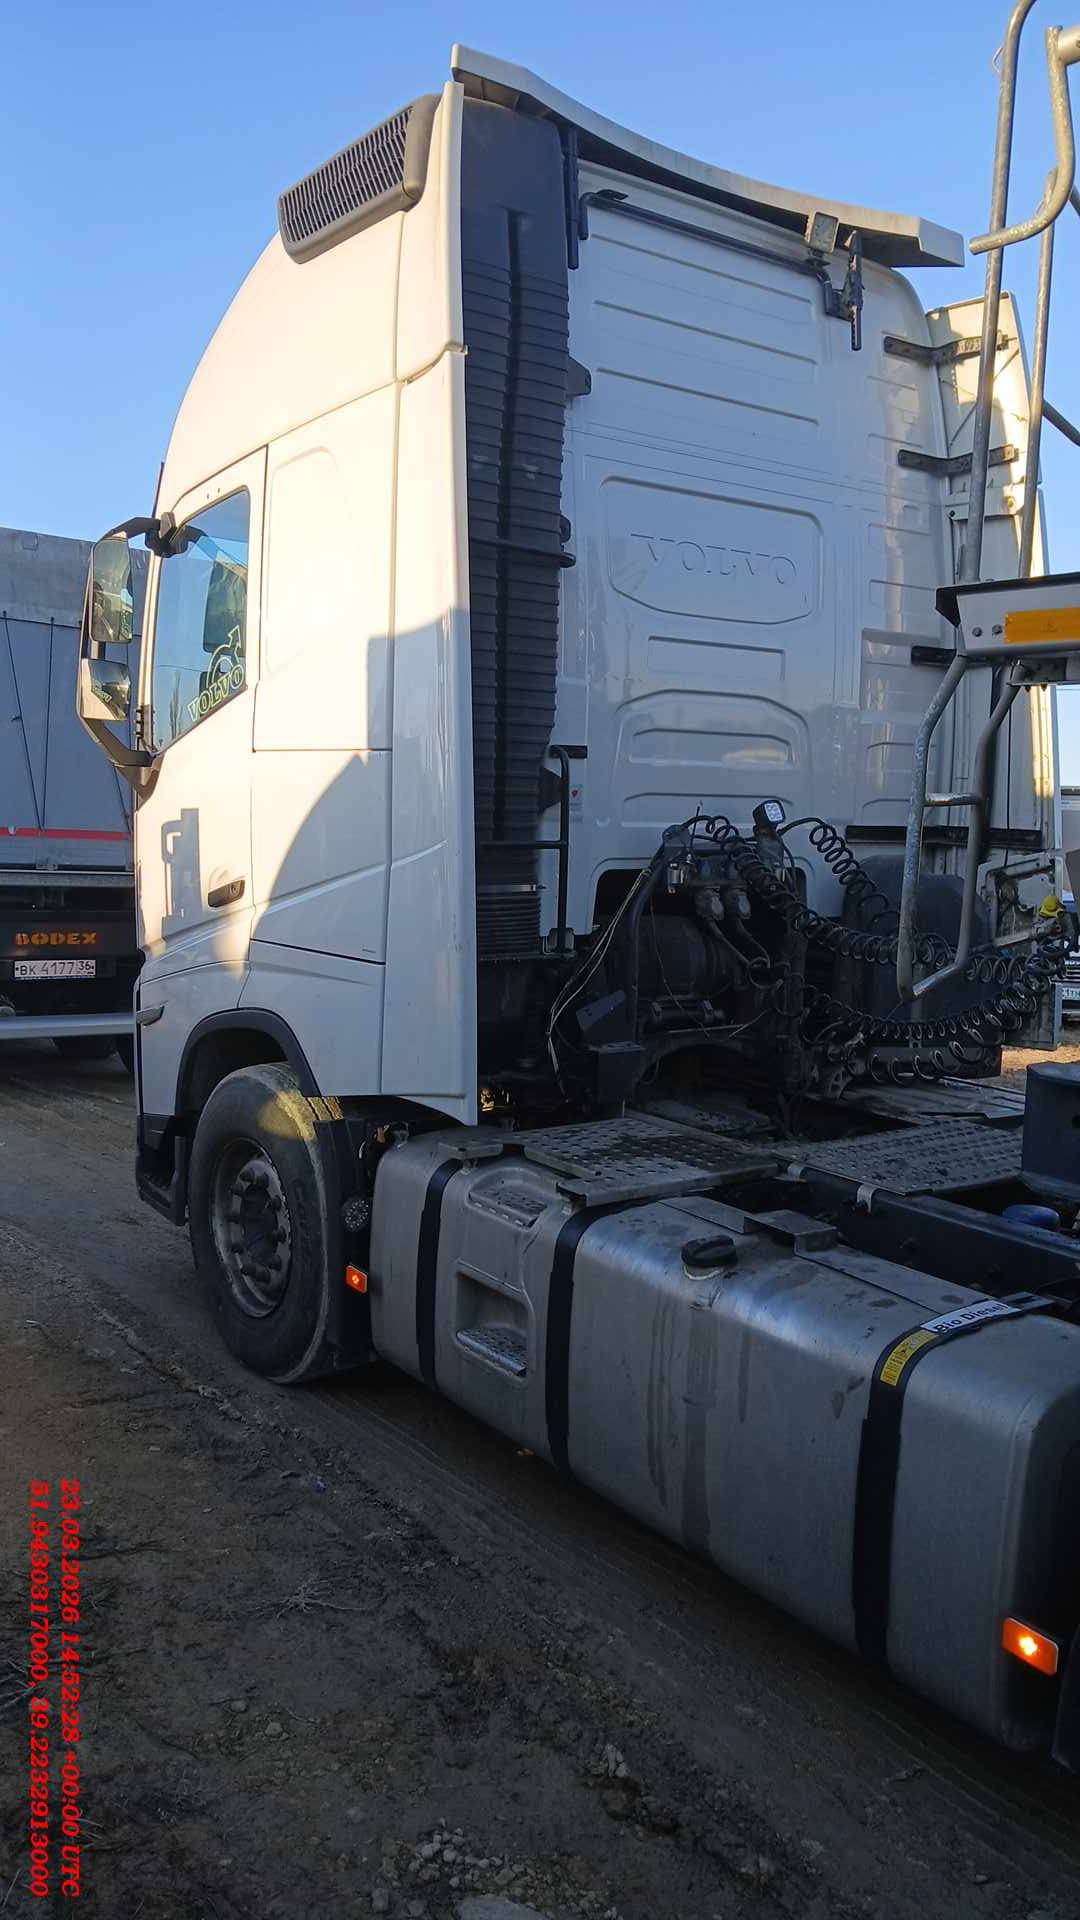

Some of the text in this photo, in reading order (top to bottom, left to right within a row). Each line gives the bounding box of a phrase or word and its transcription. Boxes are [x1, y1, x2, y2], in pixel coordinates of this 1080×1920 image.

[630, 533, 796, 585] VOLVO
[187, 664, 245, 722] VOLVO
[15, 932, 96, 944] BODEX
[40, 961, 74, 975] 4177
[78, 961, 91, 970] 36
[934, 1303, 1006, 1333] Bio Diesel
